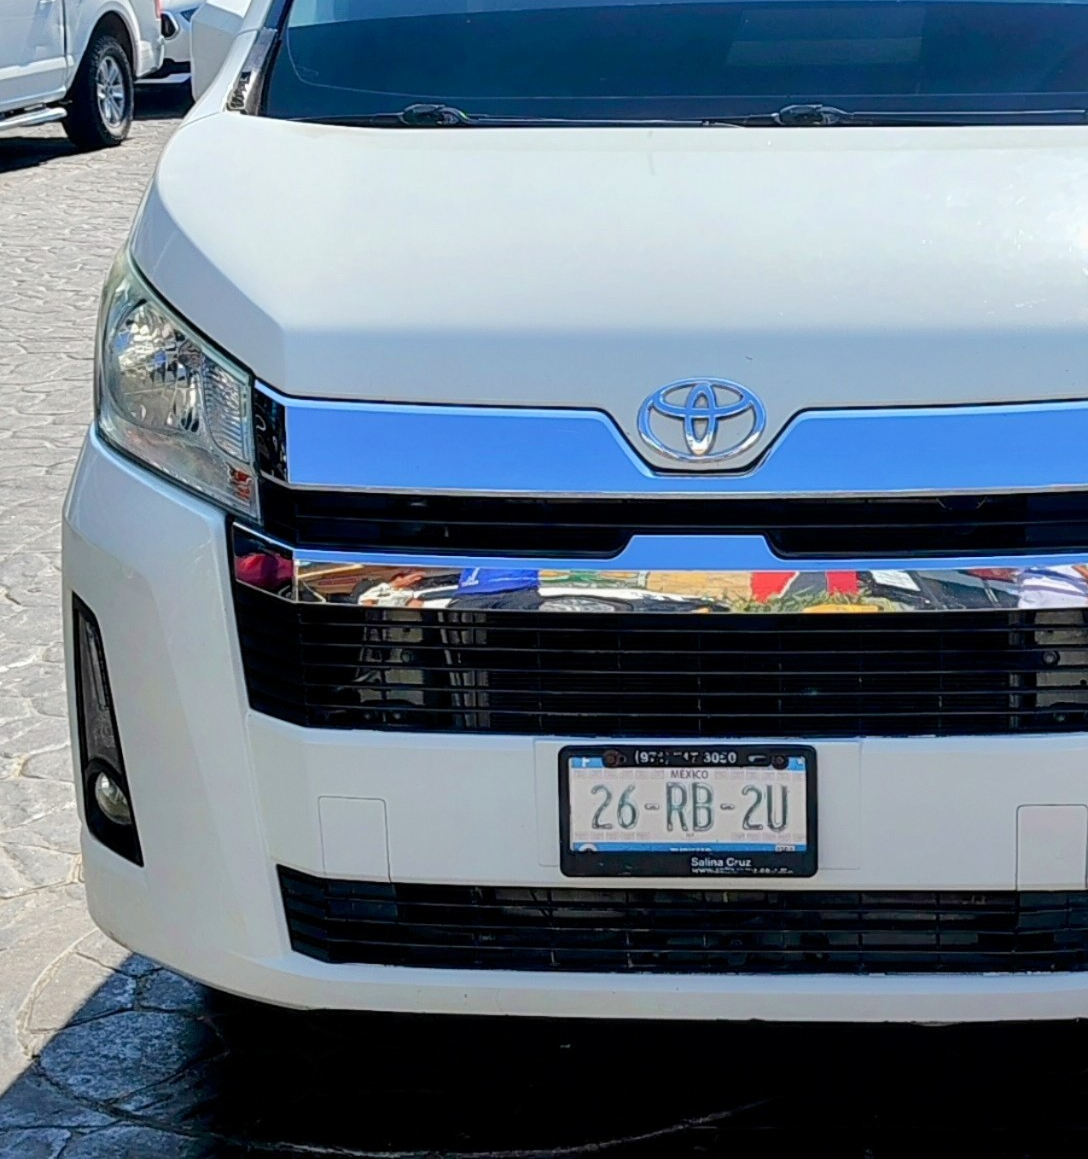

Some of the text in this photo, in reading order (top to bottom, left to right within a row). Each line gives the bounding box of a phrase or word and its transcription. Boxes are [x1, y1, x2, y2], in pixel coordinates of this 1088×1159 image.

[590, 781, 789, 833] 26-RB-2U
[691, 856, 752, 867] Salina Cruz
